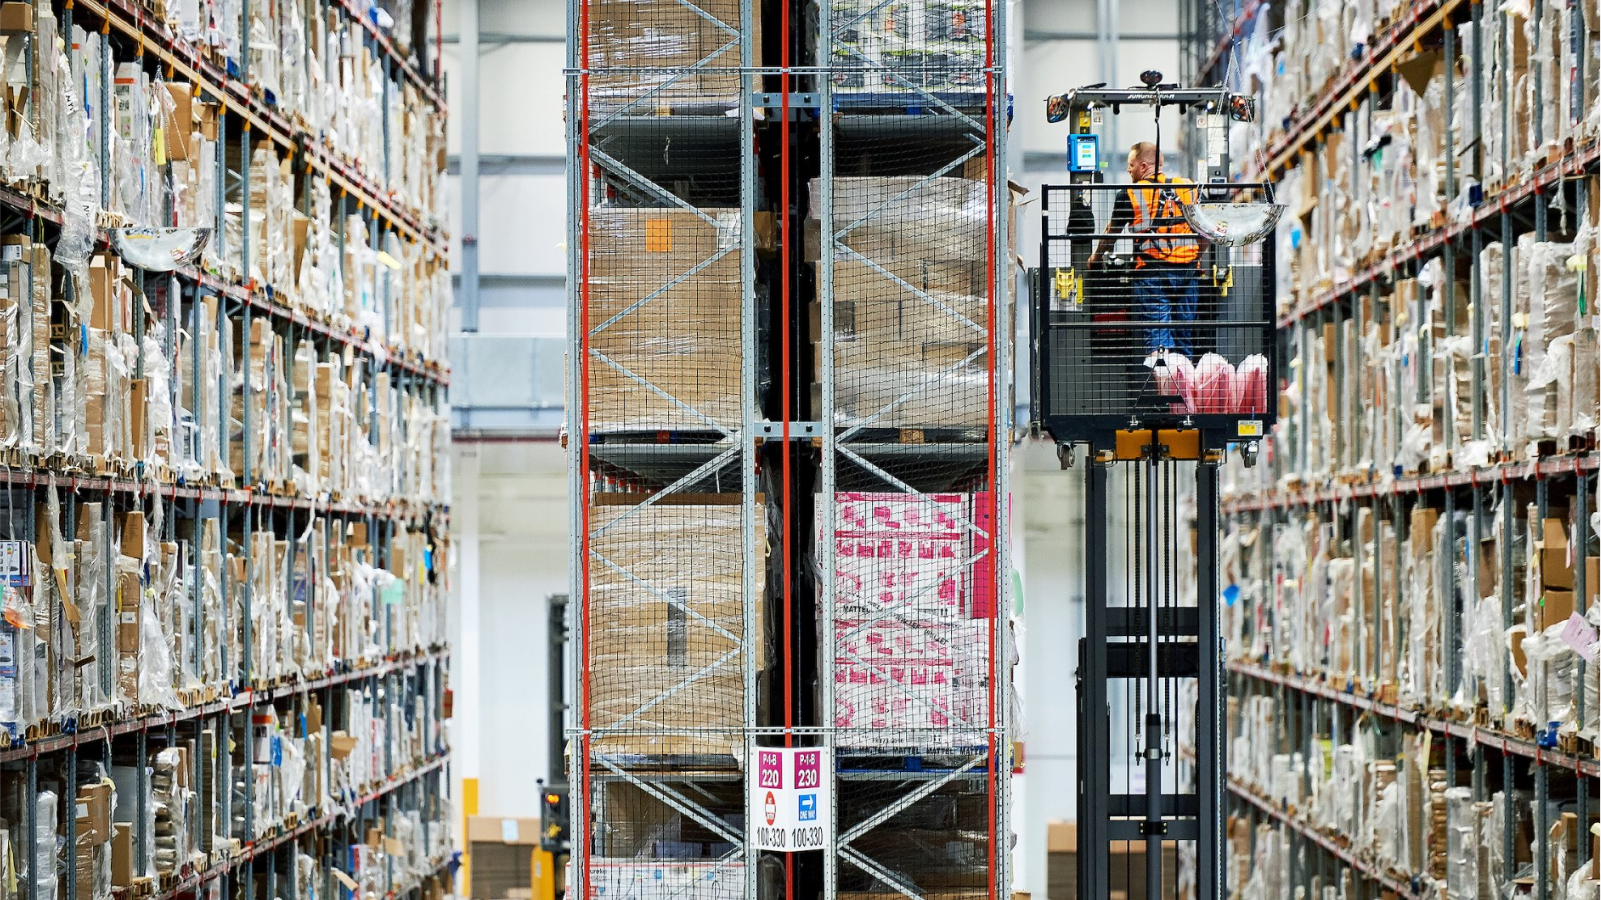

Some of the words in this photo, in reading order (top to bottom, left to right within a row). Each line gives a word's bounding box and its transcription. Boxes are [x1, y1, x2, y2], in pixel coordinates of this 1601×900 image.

[843, 605, 870, 614] MATTEL
[892, 746, 919, 755] MATTEL
[763, 754, 777, 765] P-1-B
[800, 754, 816, 765] P-1-B
[762, 769, 779, 787] 220
[798, 769, 817, 787] 230
[757, 827, 786, 847] 100-330
[792, 827, 823, 847] 100-330
